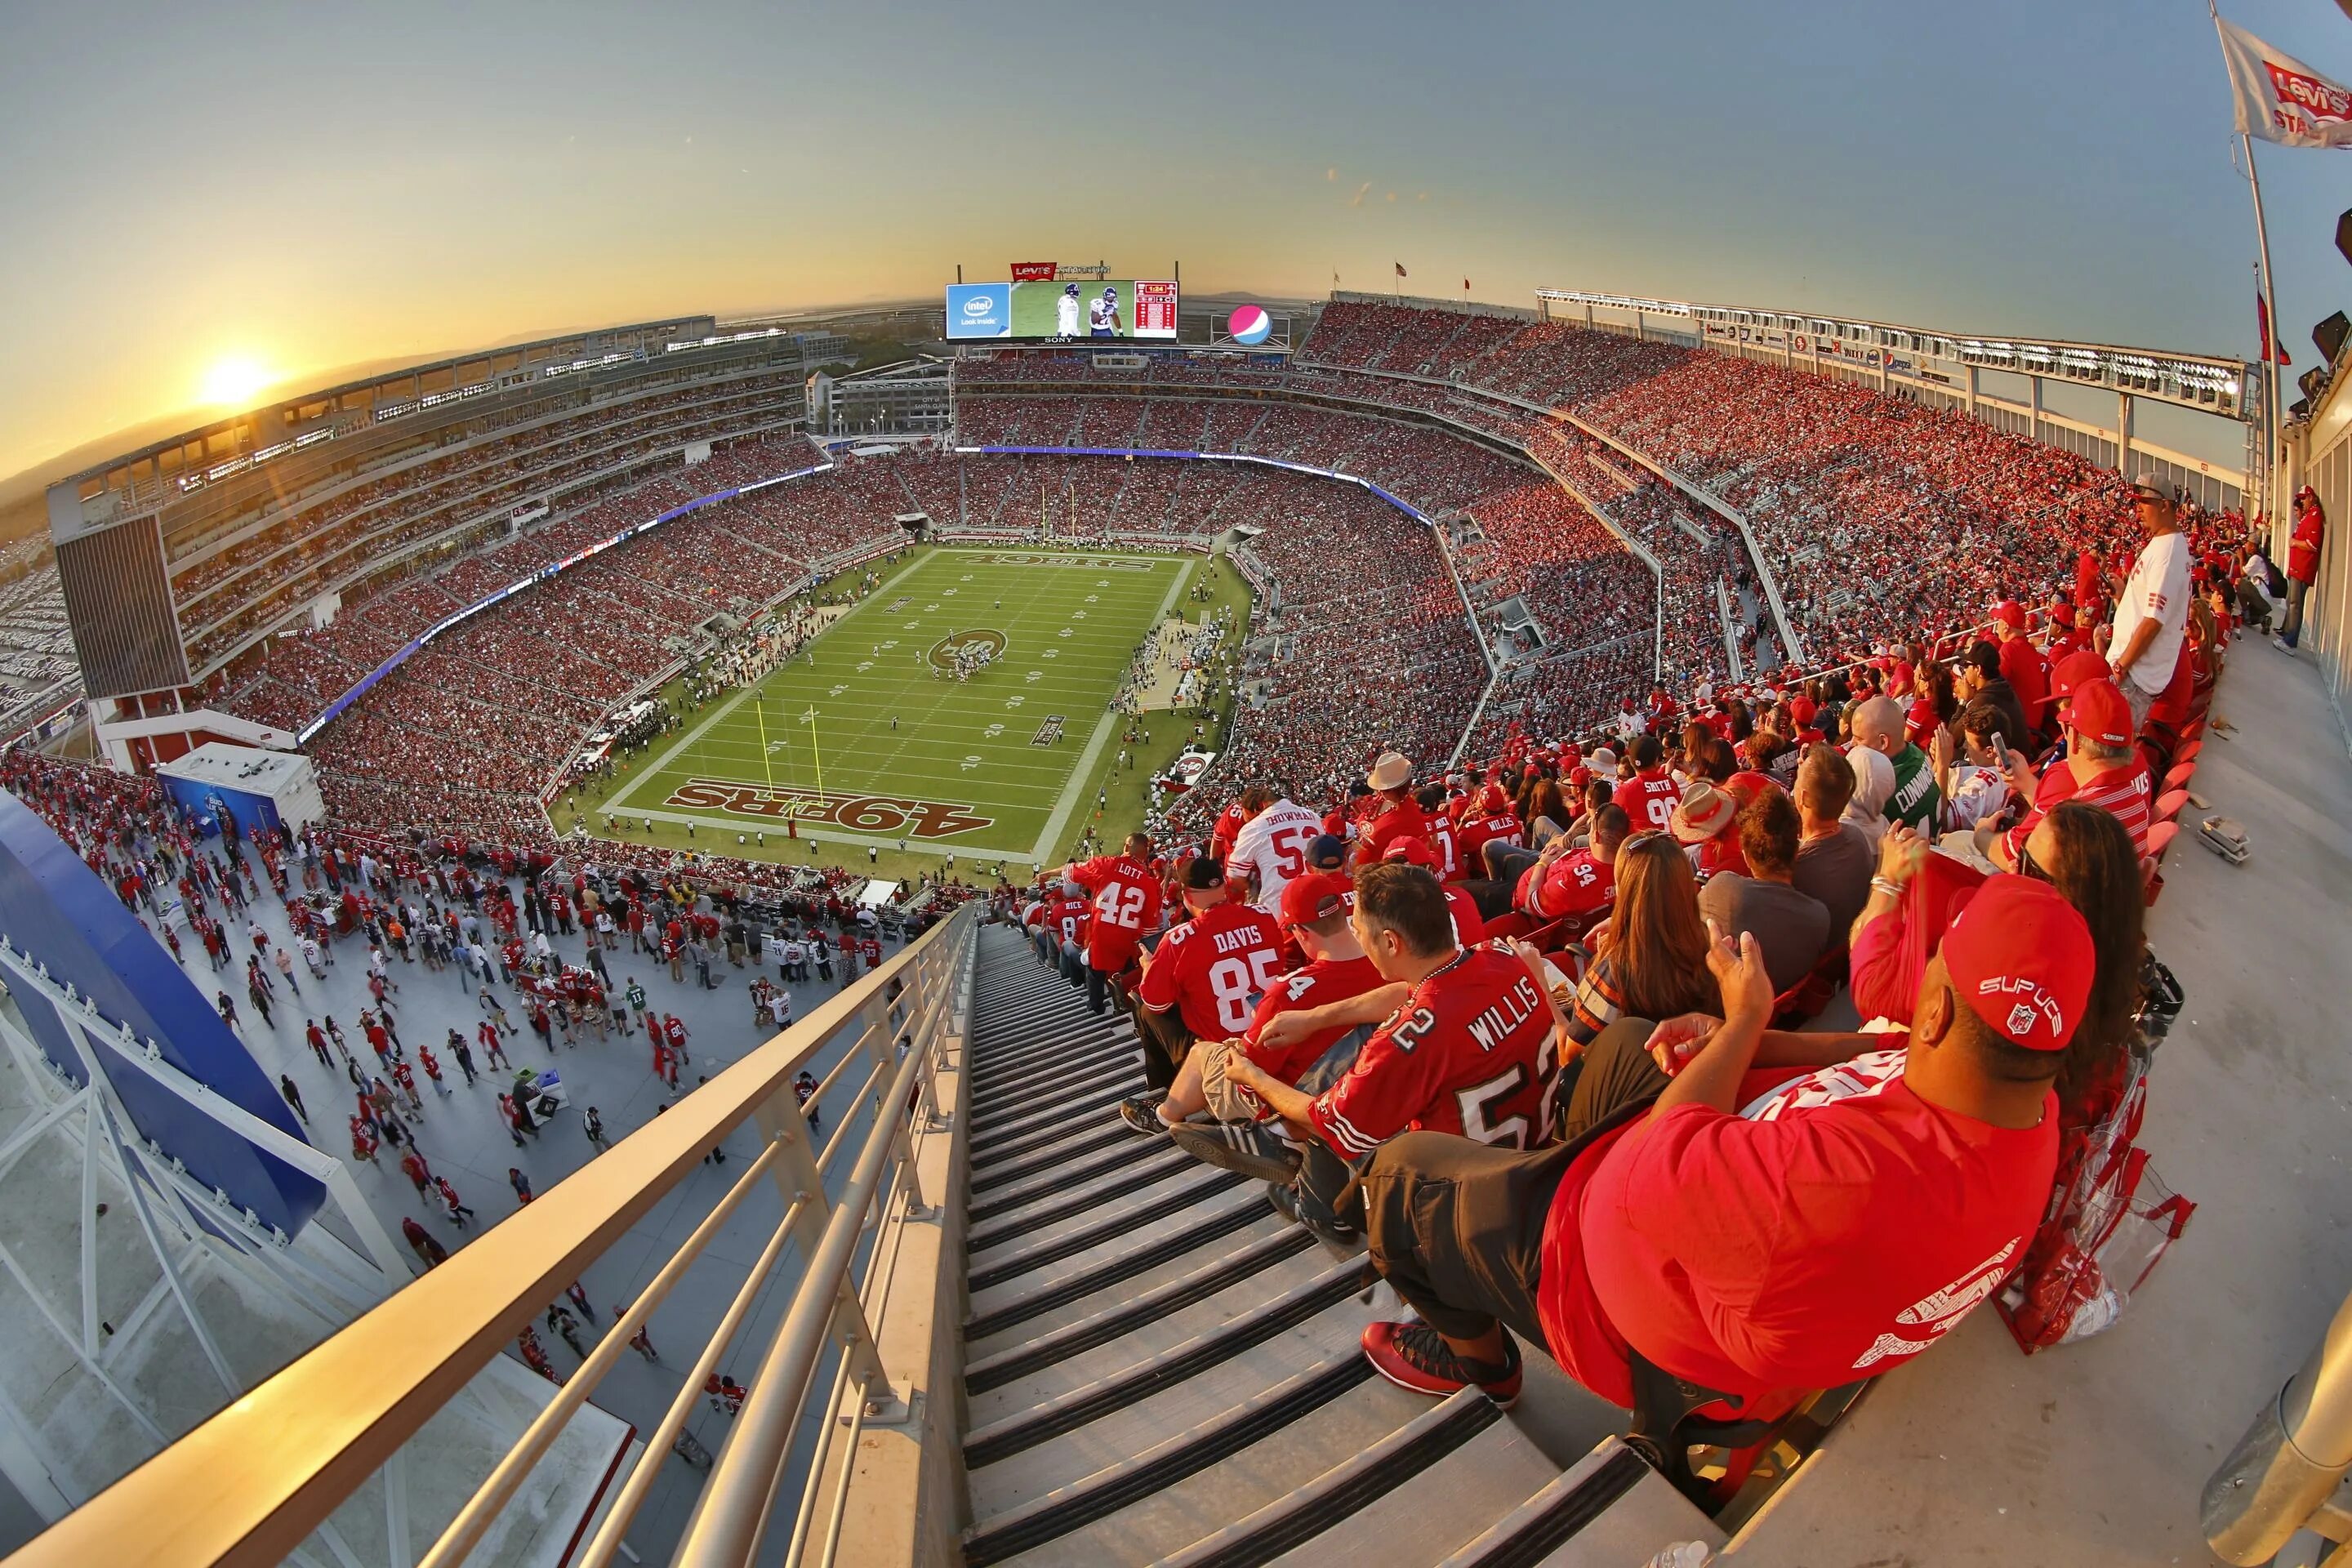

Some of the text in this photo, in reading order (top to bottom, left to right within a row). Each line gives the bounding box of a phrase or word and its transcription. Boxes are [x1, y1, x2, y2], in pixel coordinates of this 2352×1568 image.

[1894, 359, 1912, 372] pepsi
[955, 553, 1156, 572] 49ERS
[1041, 648, 1059, 658] 50
[1005, 696, 1025, 707] 30
[299, 715, 326, 744] esurance
[985, 724, 1005, 737] 20
[960, 755, 982, 769] 10
[1644, 778, 1673, 794] SMITH
[209, 796, 223, 807] BUD
[662, 777, 996, 840] 49ERS
[1487, 817, 1514, 832] WILLIS
[1437, 831, 1456, 873] 7
[1118, 862, 1143, 880] LOTT
[1573, 863, 1597, 888] 94
[1065, 901, 1083, 911] RICE
[1095, 881, 1147, 929] 42
[1213, 924, 1263, 954] DAVIS
[864, 948, 876, 958] 33
[1209, 947, 1279, 1033] 85
[1286, 976, 1316, 1002] 4
[631, 991, 643, 1004] 11
[781, 1004, 790, 1016] 16
[1467, 975, 1540, 1052] WILLIS
[670, 1024, 684, 1038] 80
[2011, 1015, 2029, 1031] NFL
[800, 1089, 813, 1098] 52
[1454, 1025, 1560, 1152] 52
